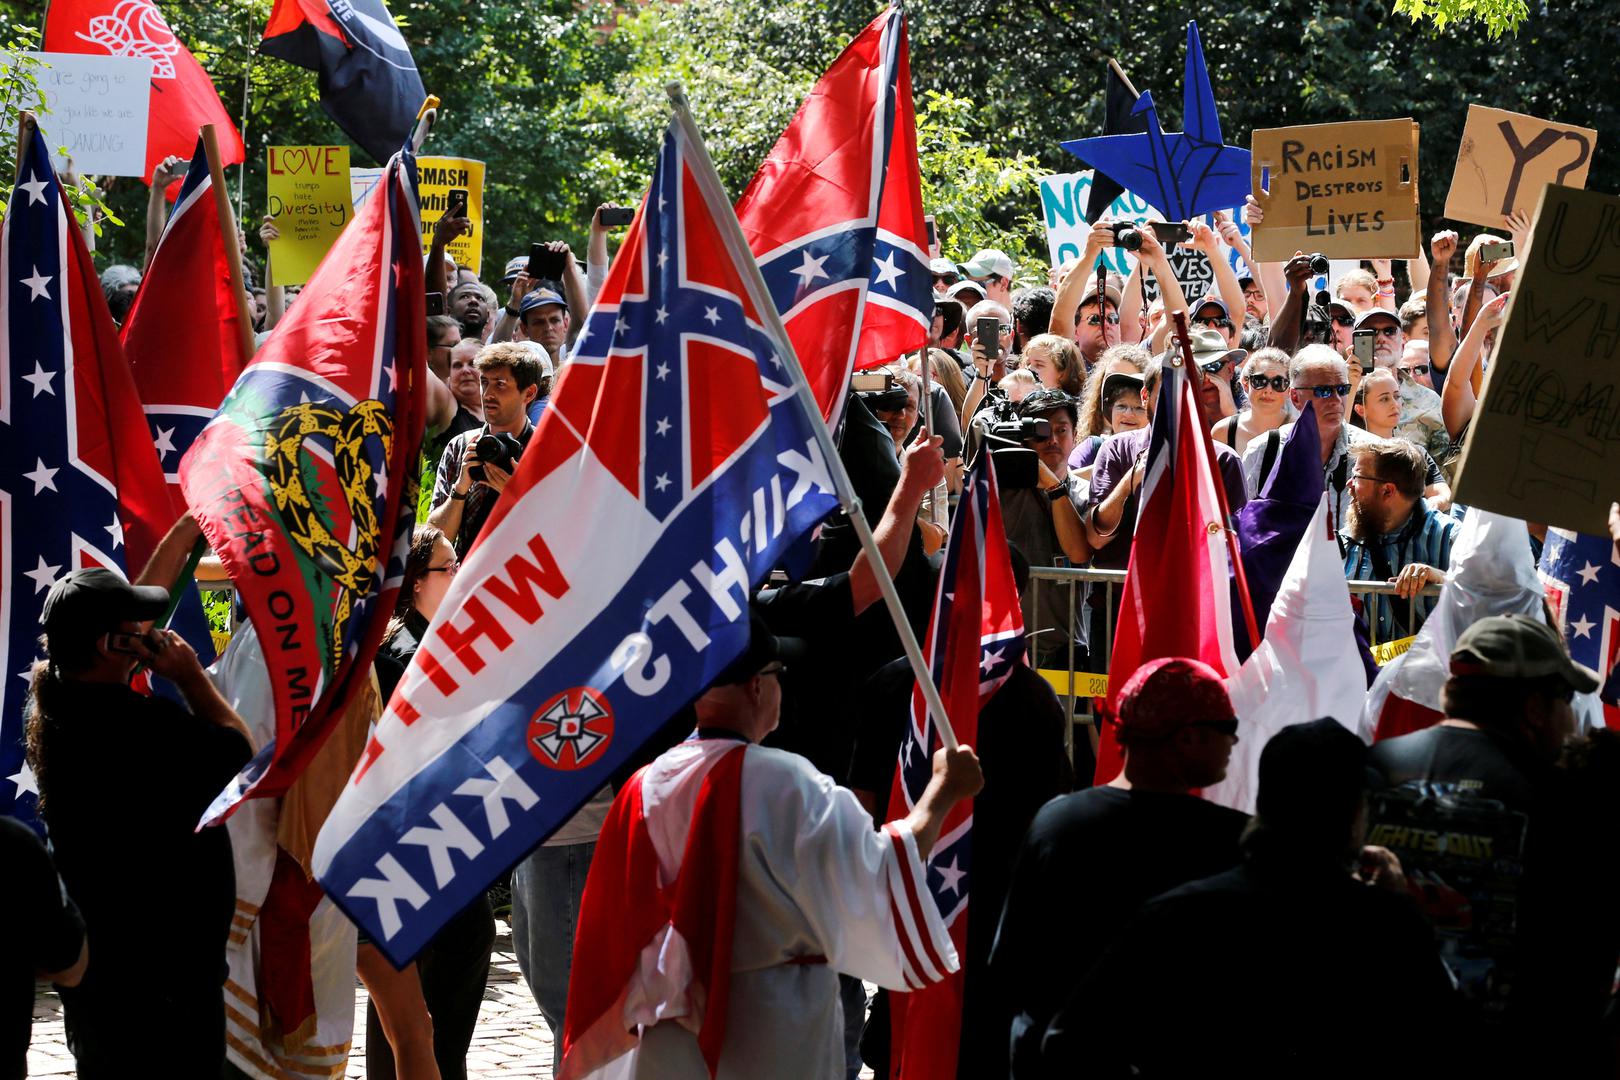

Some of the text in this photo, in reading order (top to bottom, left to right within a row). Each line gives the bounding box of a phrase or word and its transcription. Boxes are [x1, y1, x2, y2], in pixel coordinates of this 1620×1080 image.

[331, 0, 354, 22] HE
[80, 71, 110, 95] going
[57, 128, 125, 152] DANCING
[420, 193, 447, 210] whi
[1295, 180, 1383, 201] DESTROYS
[269, 195, 346, 226] Diversity
[1144, 279, 1212, 299] MTER
[267, 591, 301, 651] ON
[286, 666, 311, 732] ME
